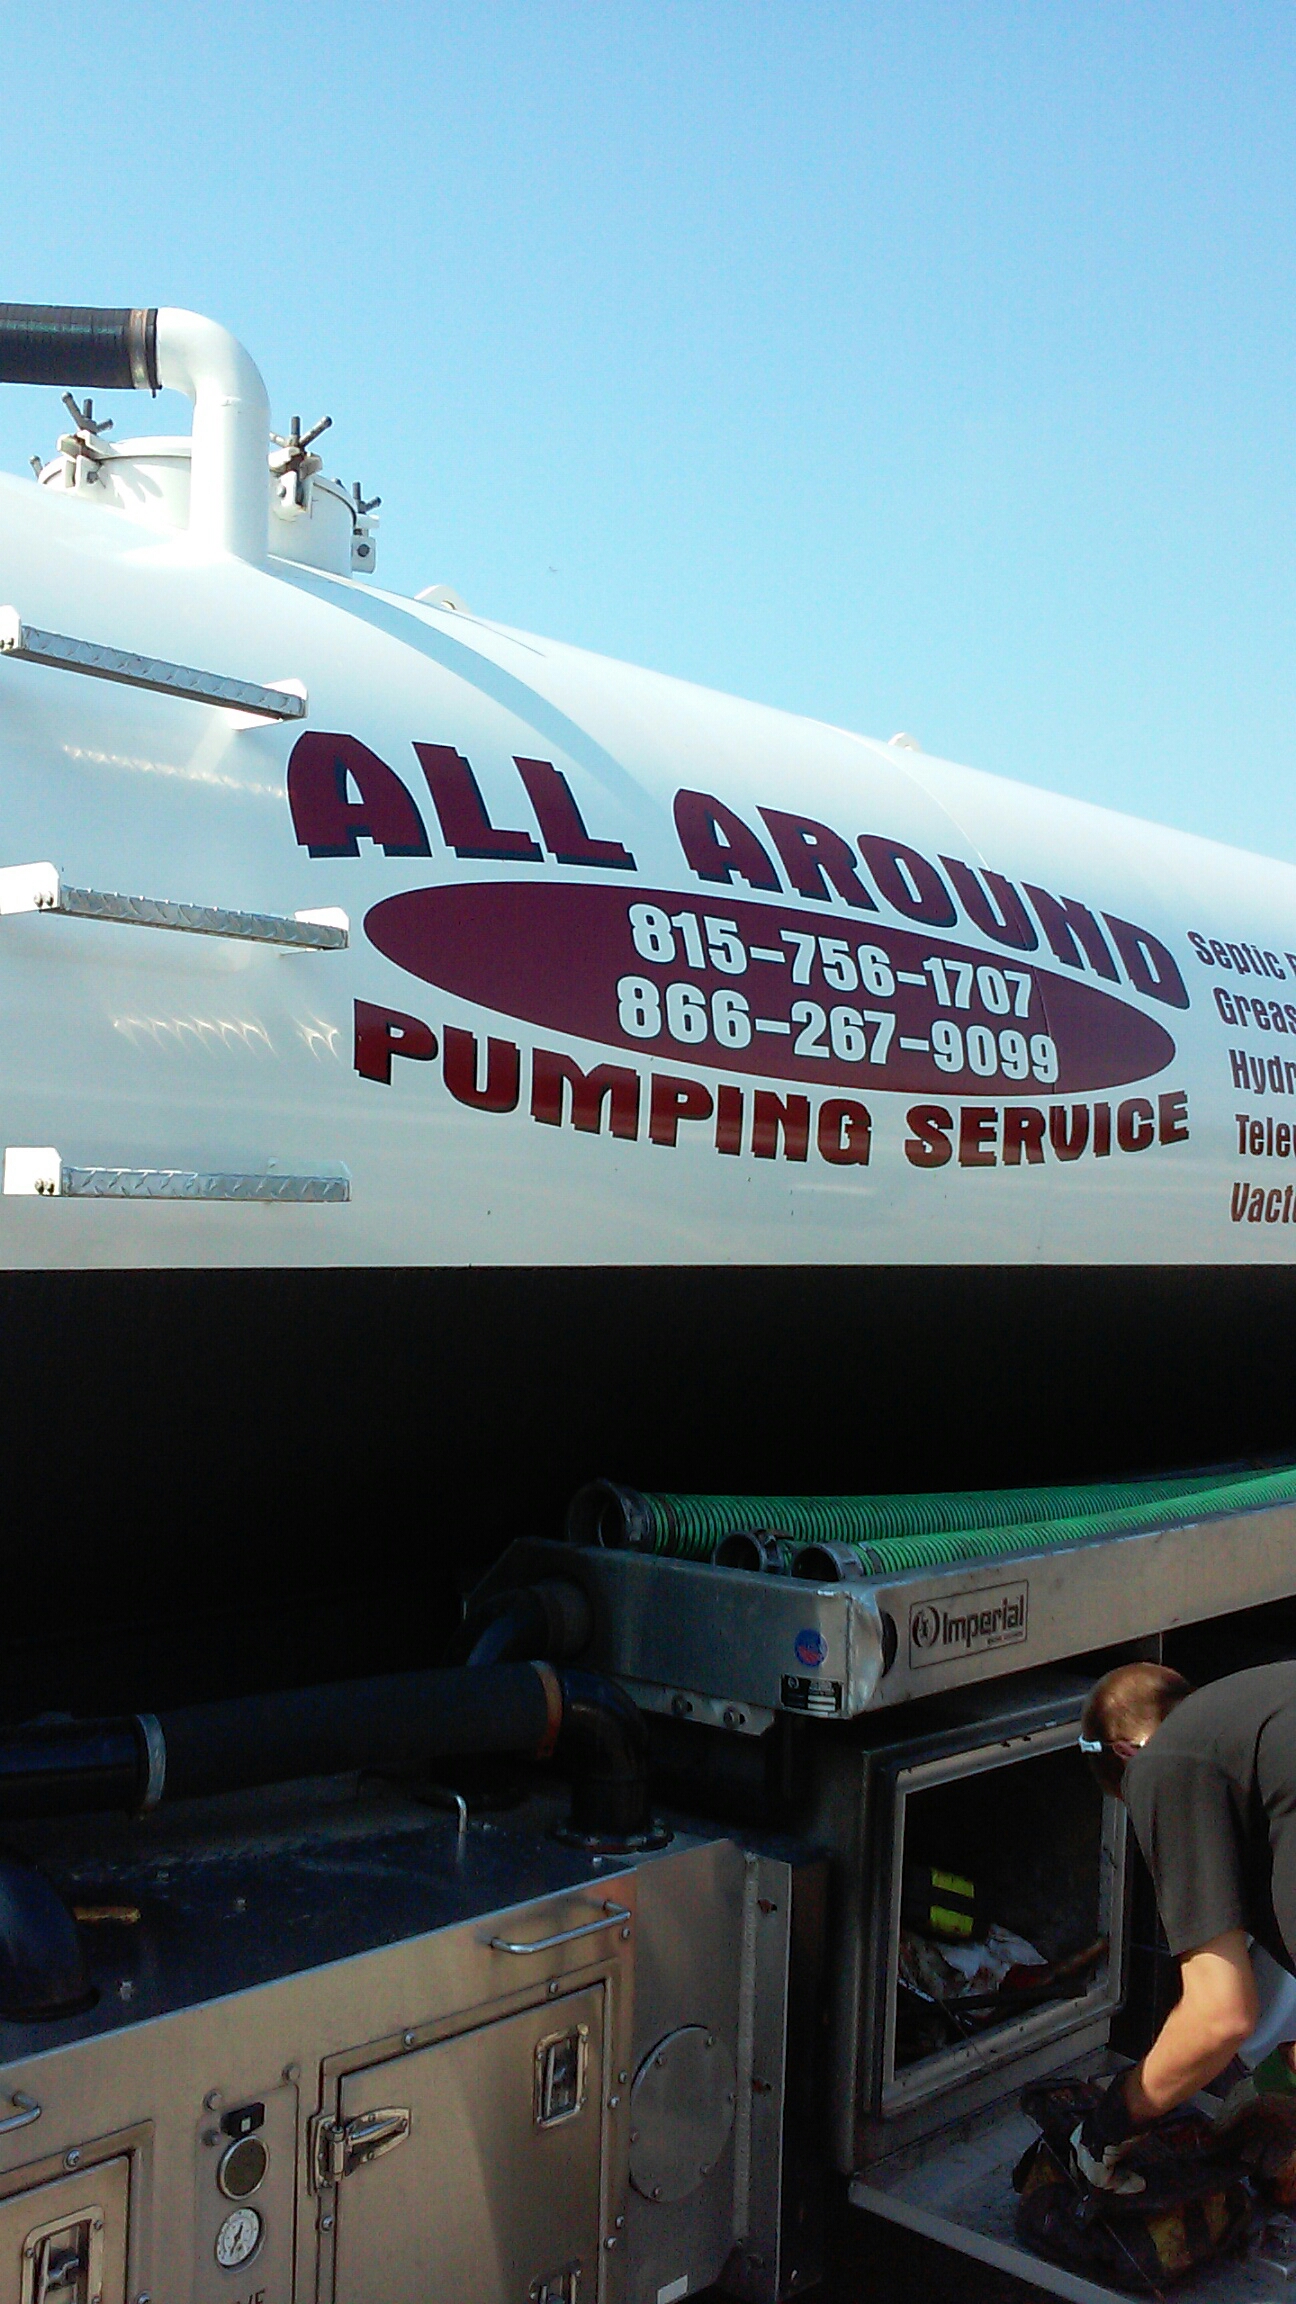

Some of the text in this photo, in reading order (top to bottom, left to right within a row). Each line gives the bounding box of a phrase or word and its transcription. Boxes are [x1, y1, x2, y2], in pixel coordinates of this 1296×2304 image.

[287, 730, 1190, 1009] ALL AROUND
[628, 903, 1032, 1019] 815-756-1707
[1187, 931, 1286, 980] Septic
[616, 975, 1059, 1084] 866-267-9099
[354, 998, 1190, 1168] PUMPING SERVICE
[1235, 1114, 1296, 1157] Tele
[1231, 1183, 1296, 1222] Vact
[942, 1594, 1025, 1648] Imperial
